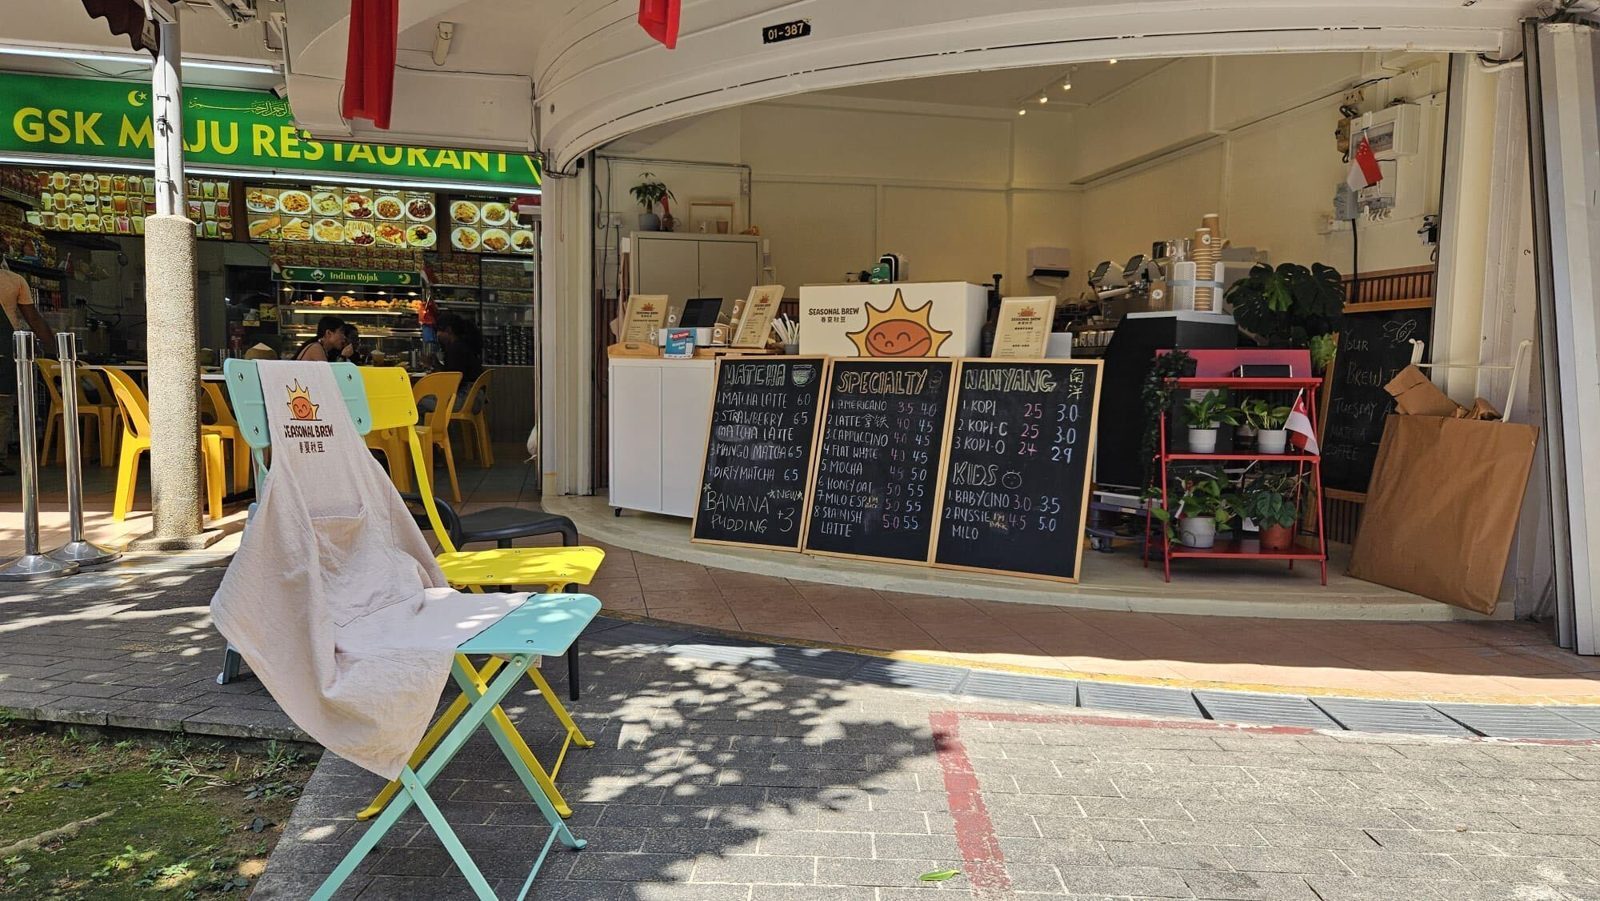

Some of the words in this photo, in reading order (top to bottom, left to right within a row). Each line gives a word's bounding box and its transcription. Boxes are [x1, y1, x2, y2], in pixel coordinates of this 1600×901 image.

[768, 22, 804, 40] 01-387
[13, 107, 105, 147] GSK
[118, 113, 239, 154] MJU
[329, 272, 357, 281] Indian
[357, 273, 379, 283] Rojak
[808, 307, 840, 316] SEASONAL
[841, 307, 860, 315] BREW
[724, 364, 786, 387] MATCHA
[837, 369, 928, 396] SPECIALTY
[964, 368, 1057, 393] NANYANG
[1066, 367, 1085, 400] 南洋
[722, 391, 757, 406] MATCHA
[761, 392, 787, 408] LATTE
[838, 399, 887, 411] AMERICANO
[722, 409, 783, 427] STRAWBERRY
[971, 400, 996, 416] KOPI
[1023, 403, 1042, 419] 2.5
[1057, 404, 1079, 422] 3.0
[835, 415, 860, 427] LATTE
[315, 424, 334, 438] BREW
[718, 424, 757, 440] MATCHA
[763, 426, 793, 441] LATTE
[832, 428, 888, 447] CAPPUCCINO
[968, 419, 1008, 437] KOPI-C
[1021, 423, 1040, 439] 2.5
[1054, 426, 1077, 445] 3.0
[716, 443, 748, 459] MANGO
[752, 444, 786, 460] MATCHA
[832, 444, 849, 457] FLAT
[853, 447, 879, 459] WHITE
[963, 437, 1006, 455] KOPI-O
[1018, 441, 1037, 456] 2.4
[1051, 446, 1073, 464] 2.9
[714, 466, 739, 480] DIRTY
[829, 460, 863, 476] MOCHA
[953, 461, 999, 486] KIDS
[827, 477, 855, 493] HONEY
[856, 481, 872, 493] OAT
[705, 491, 769, 514] BANANA
[825, 492, 848, 505] MILO
[849, 494, 866, 508] ESP
[955, 490, 1010, 508] BABYCINO
[1013, 494, 1032, 512] 3.0
[1040, 495, 1061, 514] 3.5
[711, 511, 768, 534] PUDDING
[822, 506, 862, 523] SPANISH
[954, 506, 990, 523] AUSSIE
[1008, 513, 1027, 530] 4.5
[1038, 516, 1057, 532] 5.0
[821, 521, 852, 538] LATTE
[952, 524, 979, 540] MILO
